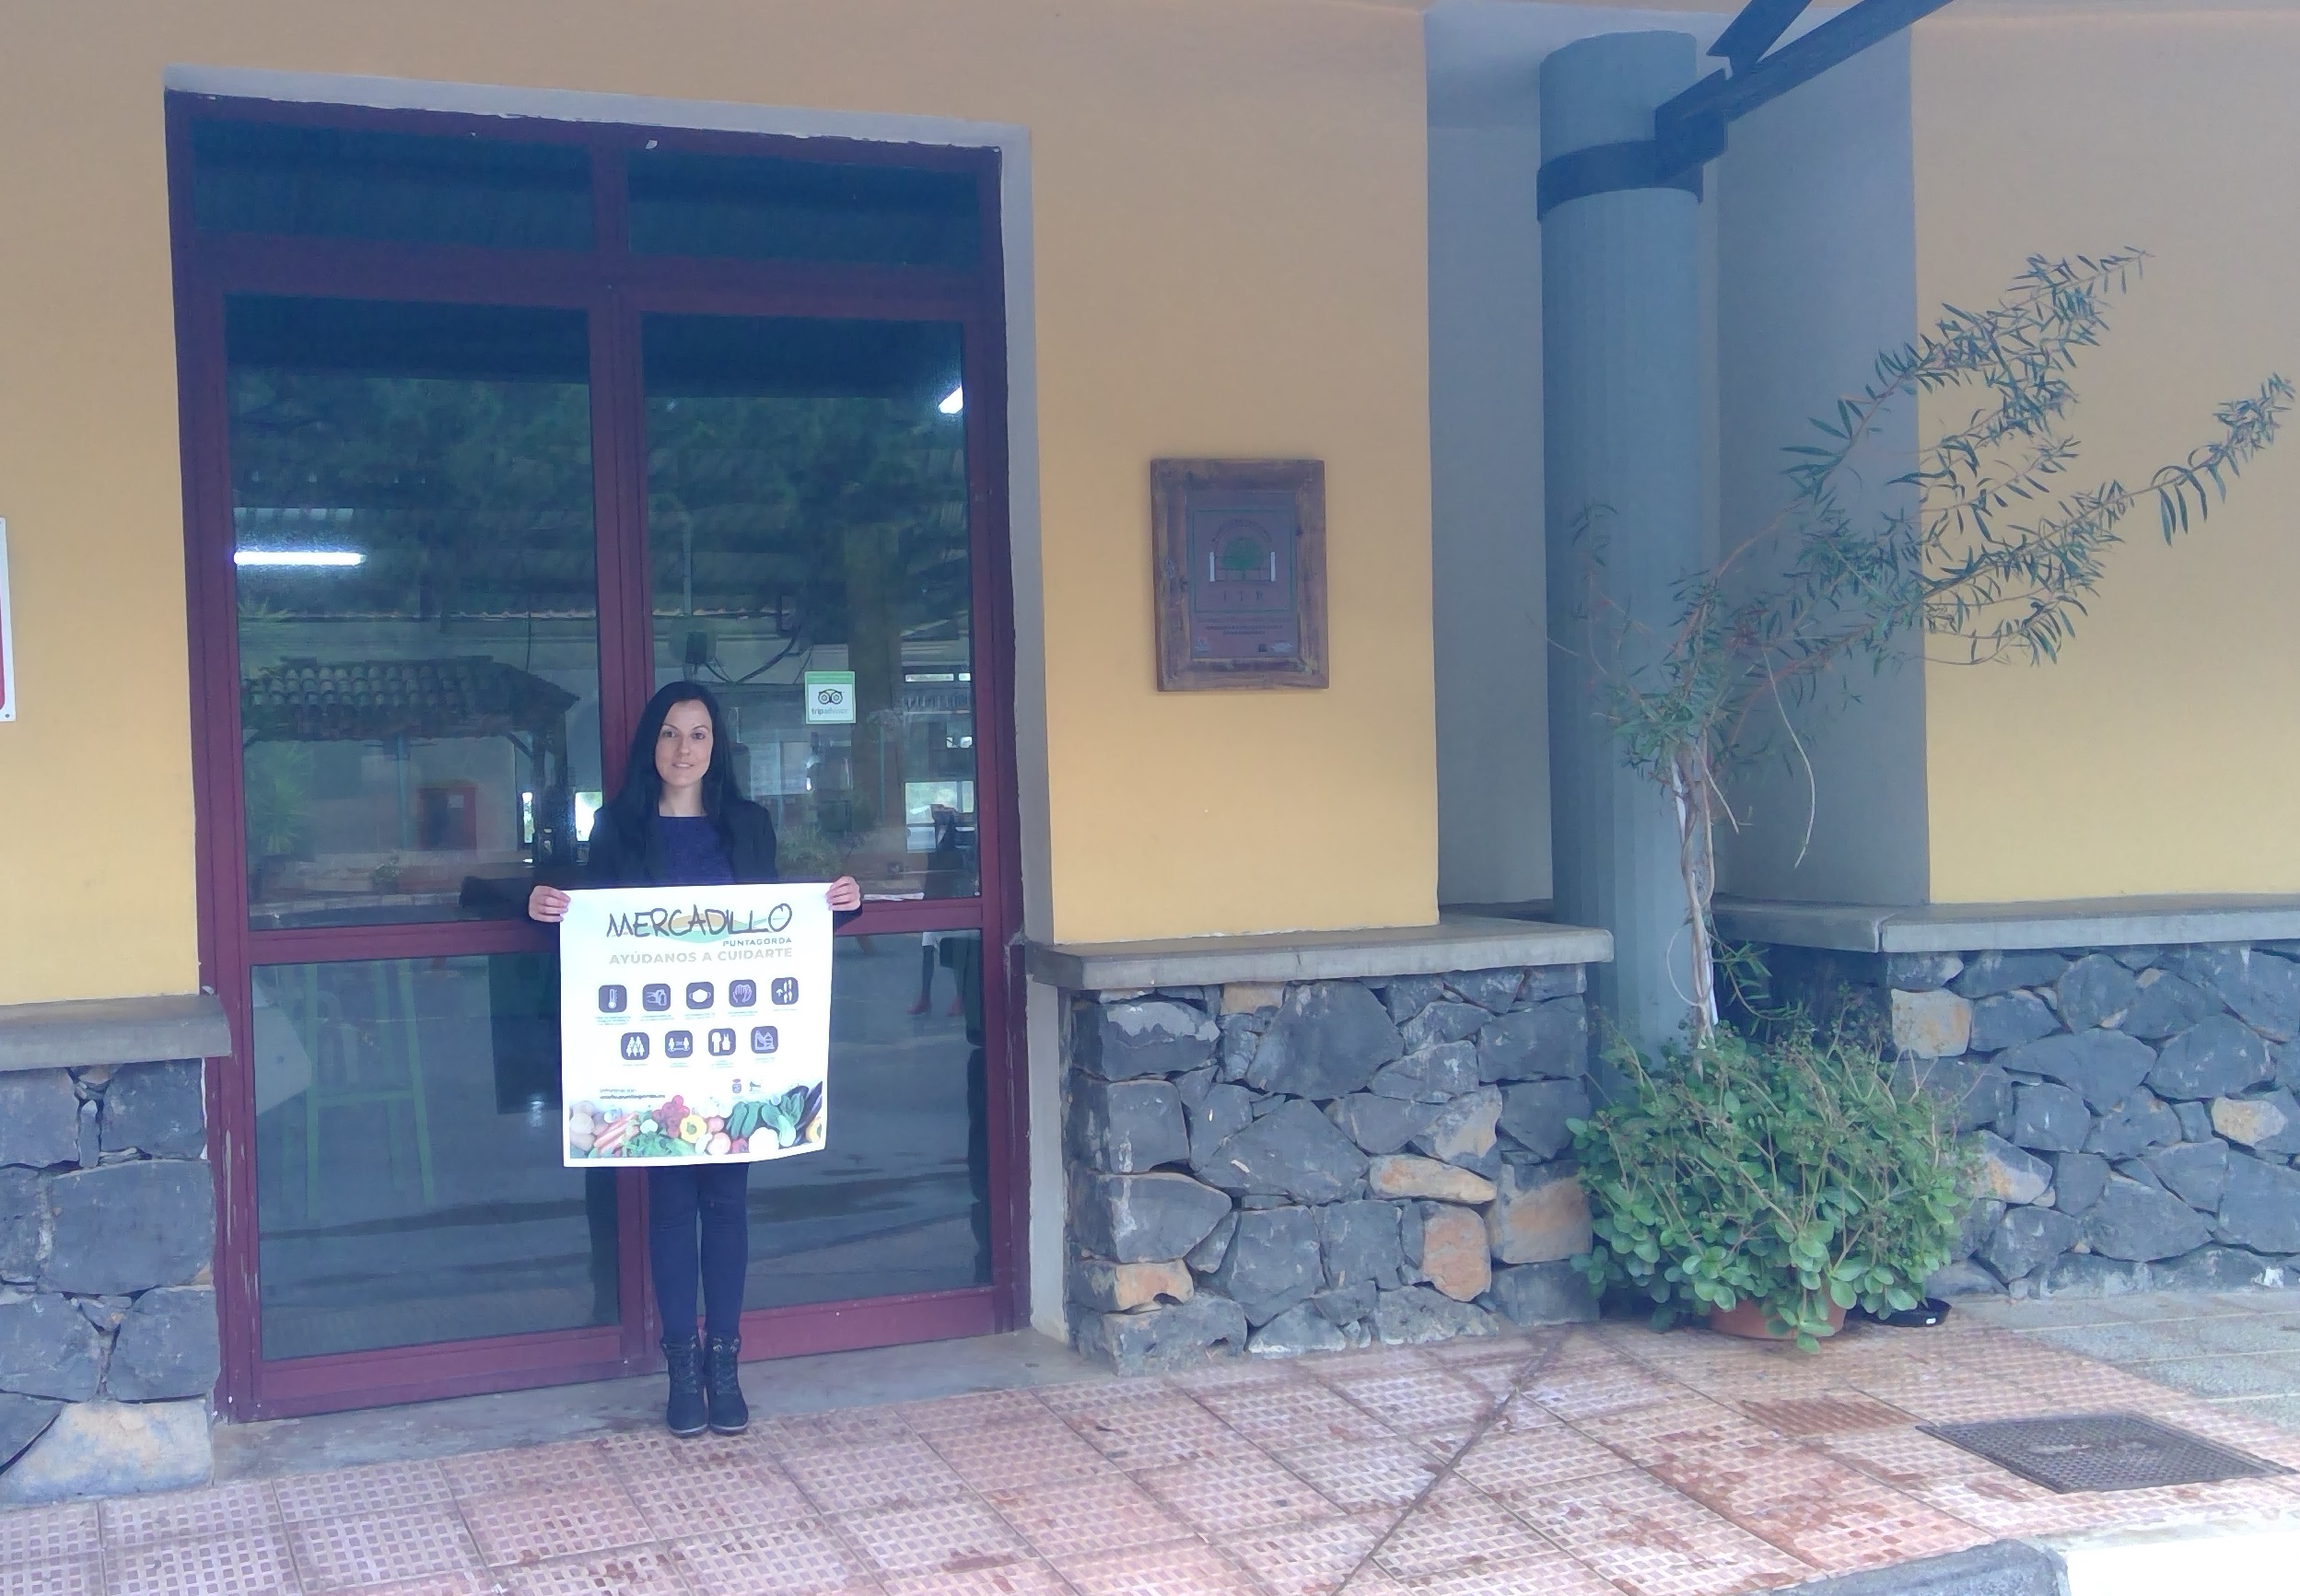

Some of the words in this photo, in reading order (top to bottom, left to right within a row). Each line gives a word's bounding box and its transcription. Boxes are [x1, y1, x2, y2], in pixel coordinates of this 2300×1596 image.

[606, 903, 793, 938] MERCADILLO
[722, 938, 793, 947] PUNTAGORDA
[609, 951, 696, 965] AYÚDANOS
[702, 951, 712, 962] A
[717, 948, 793, 961] CUIDARTE
